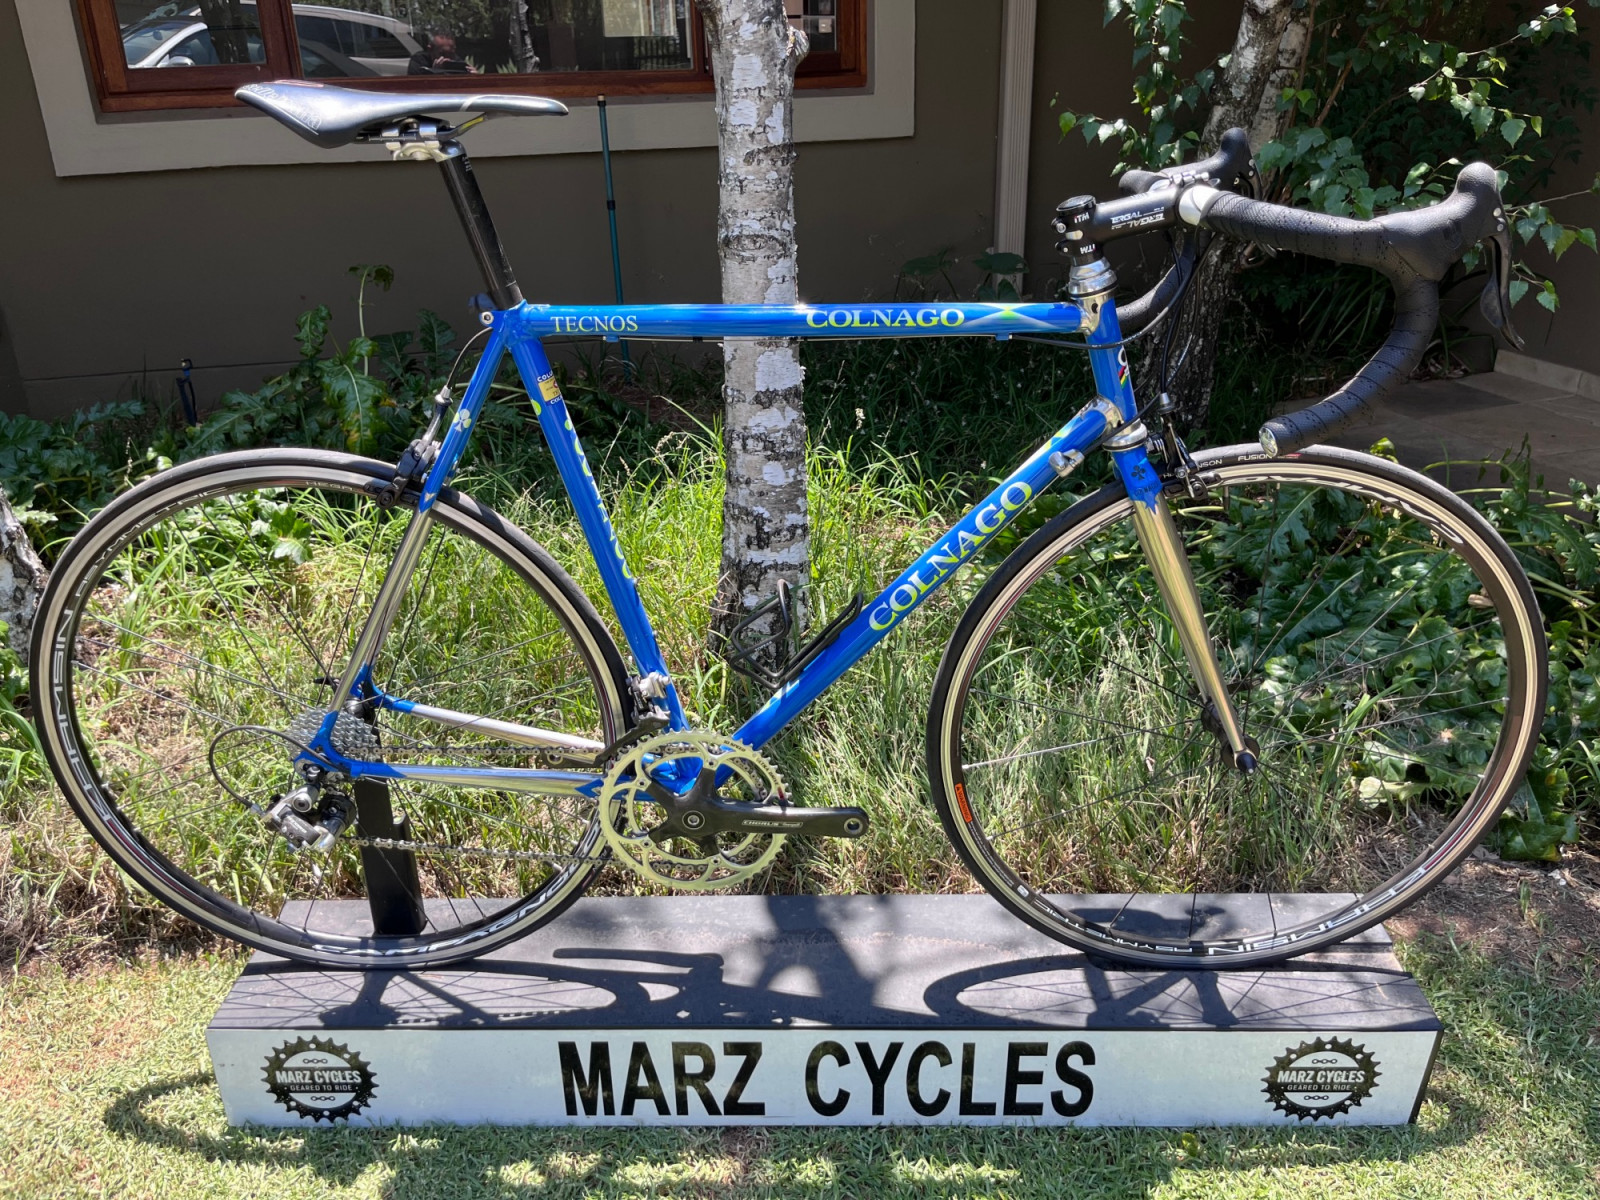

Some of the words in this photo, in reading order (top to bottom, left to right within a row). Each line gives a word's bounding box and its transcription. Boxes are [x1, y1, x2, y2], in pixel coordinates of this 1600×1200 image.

[1074, 212, 1089, 223] ITM
[550, 315, 639, 332] TECNOS
[806, 308, 965, 328] COLNAGO
[869, 481, 1032, 631] COLNAGO
[275, 1070, 312, 1083] MARZ
[314, 1070, 362, 1084] CYCLES
[558, 1040, 766, 1116] MARZ
[804, 1040, 1096, 1117] CYCLES
[1277, 1070, 1315, 1083] MARZ
[1316, 1070, 1366, 1083] CYCLES
